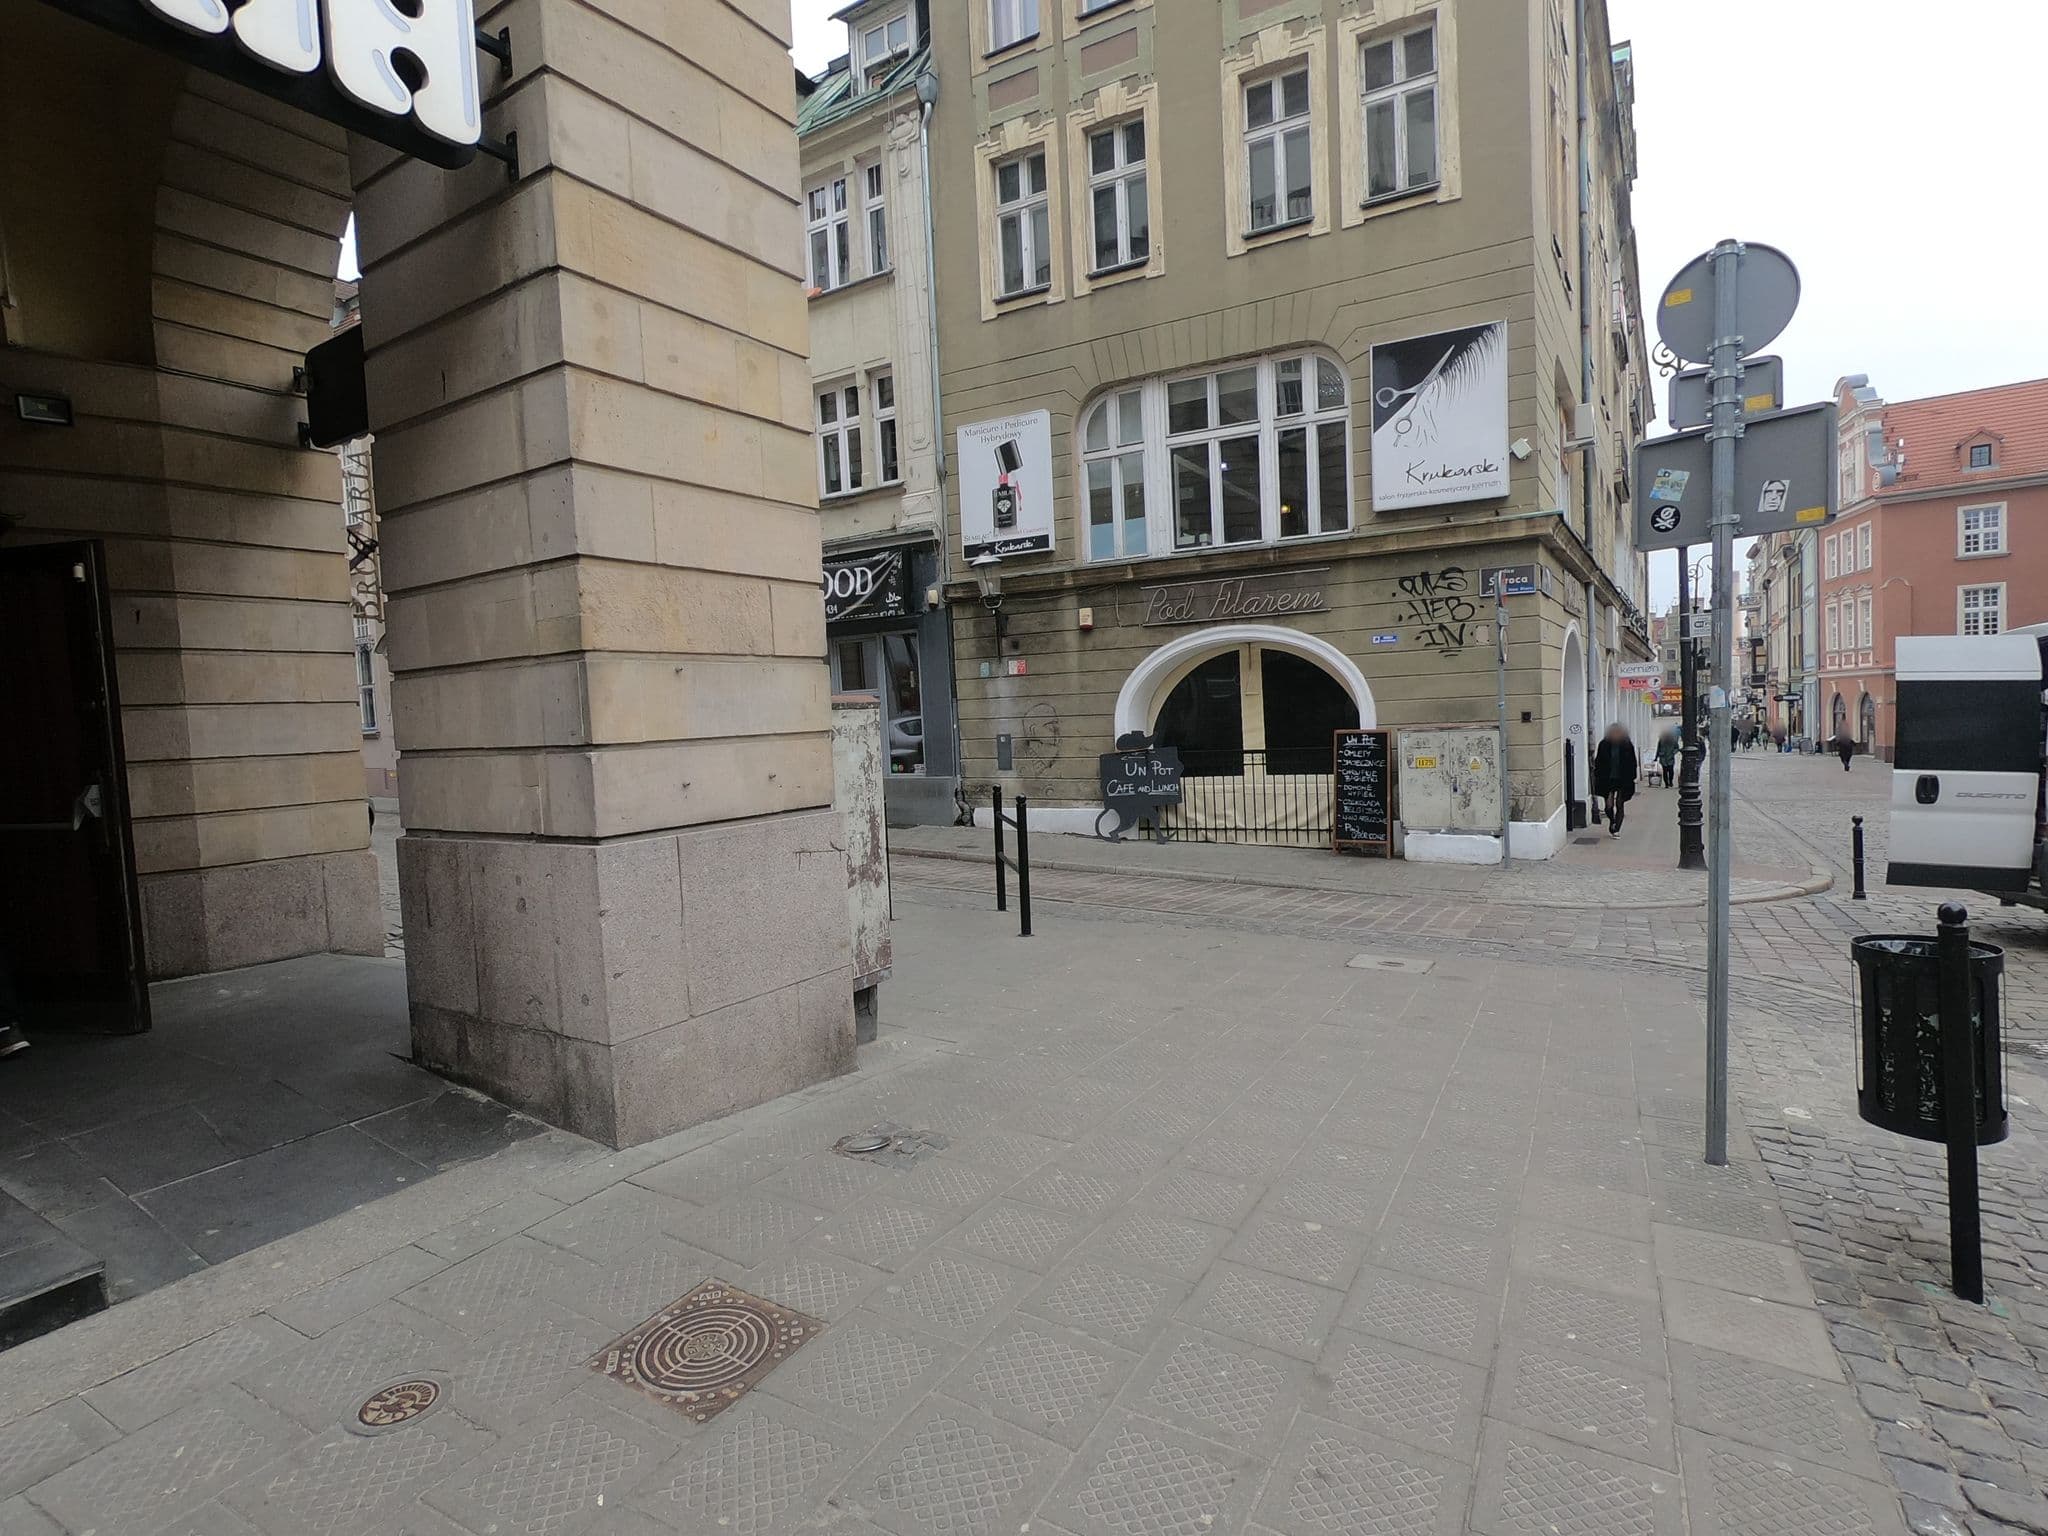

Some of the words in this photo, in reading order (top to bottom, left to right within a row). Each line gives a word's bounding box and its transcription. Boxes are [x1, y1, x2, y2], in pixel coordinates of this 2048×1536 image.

[964, 424, 999, 438] Manicure
[1004, 417, 1038, 431] Pedicure
[980, 430, 1023, 444] Hybrydowy
[347, 450, 384, 624] BROARIA
[822, 566, 873, 600] OOD
[1145, 587, 1196, 622] Pod
[1209, 580, 1324, 617] Filarem
[1124, 762, 1147, 776] UN
[1150, 760, 1175, 776] POT
[1106, 779, 1135, 796] CAFE
[1151, 779, 1179, 793] LUNCH
[1955, 791, 2027, 799] DUCATO
